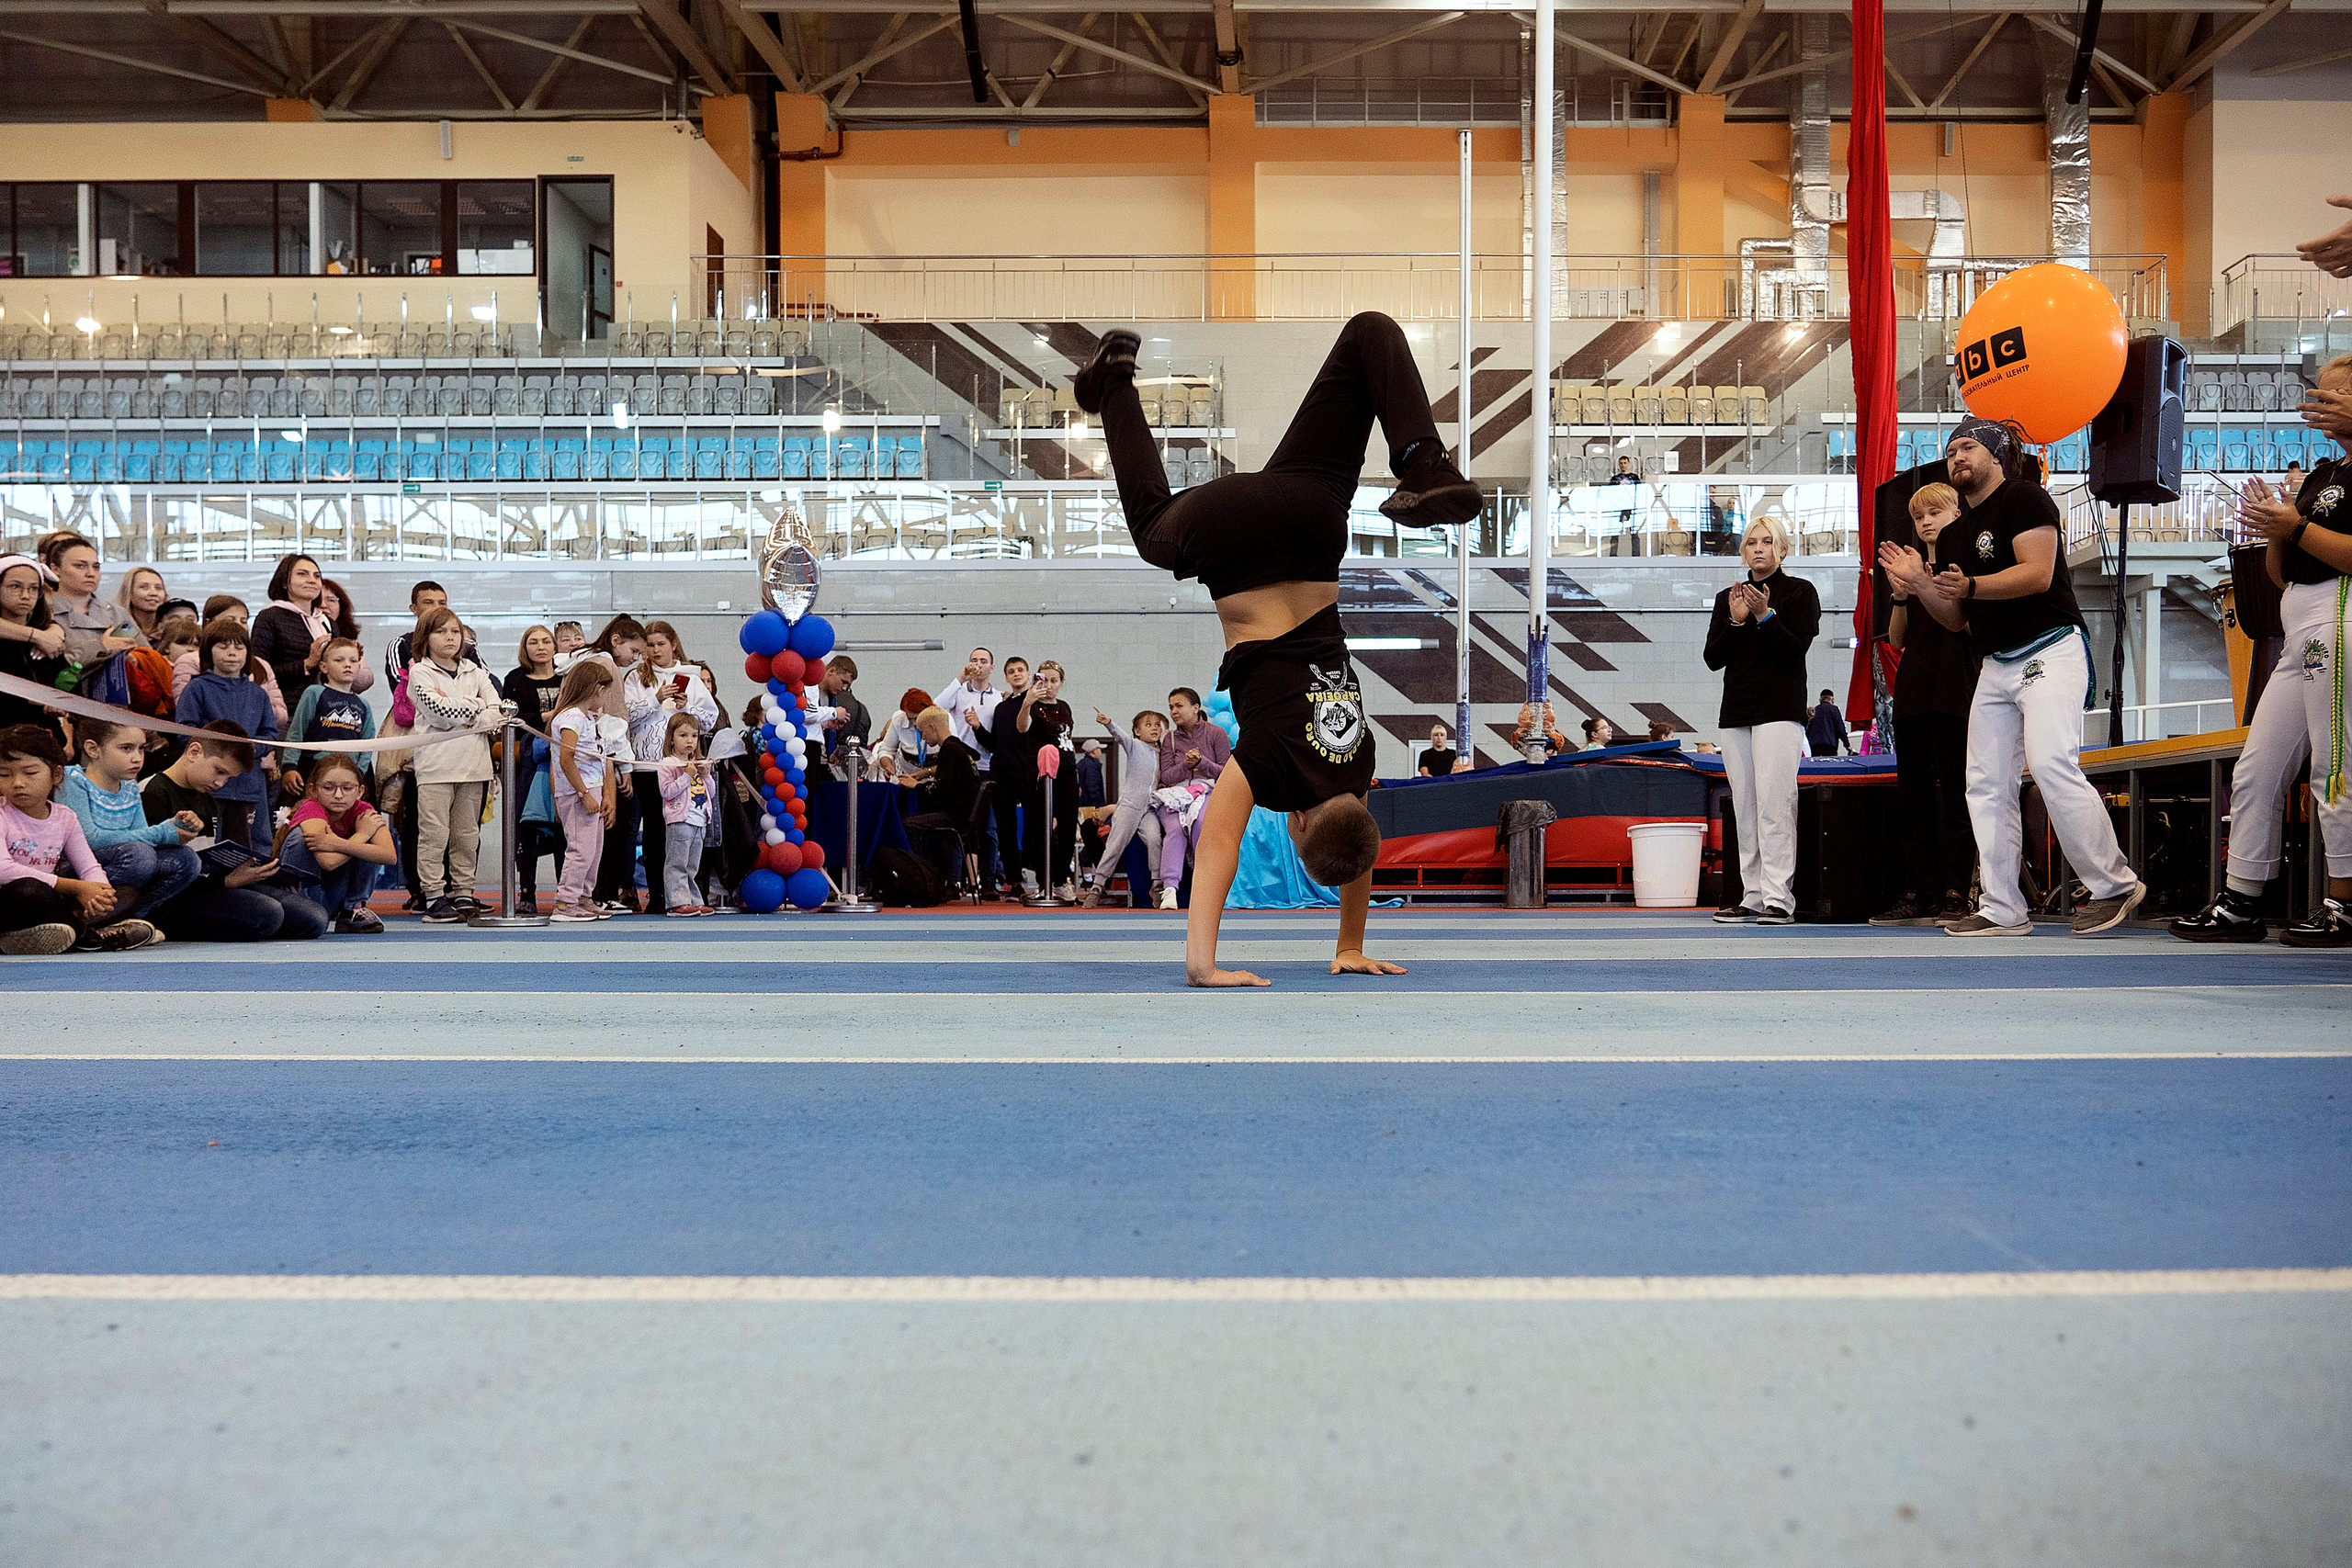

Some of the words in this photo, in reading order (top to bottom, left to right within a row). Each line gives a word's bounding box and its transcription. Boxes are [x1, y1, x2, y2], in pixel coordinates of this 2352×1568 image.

[2006, 364, 2030, 378] ЦЕНТР
[1306, 691, 1361, 703] CAPOEIRA
[1306, 722, 1328, 757] OURO
[1329, 752, 1342, 764] DE
